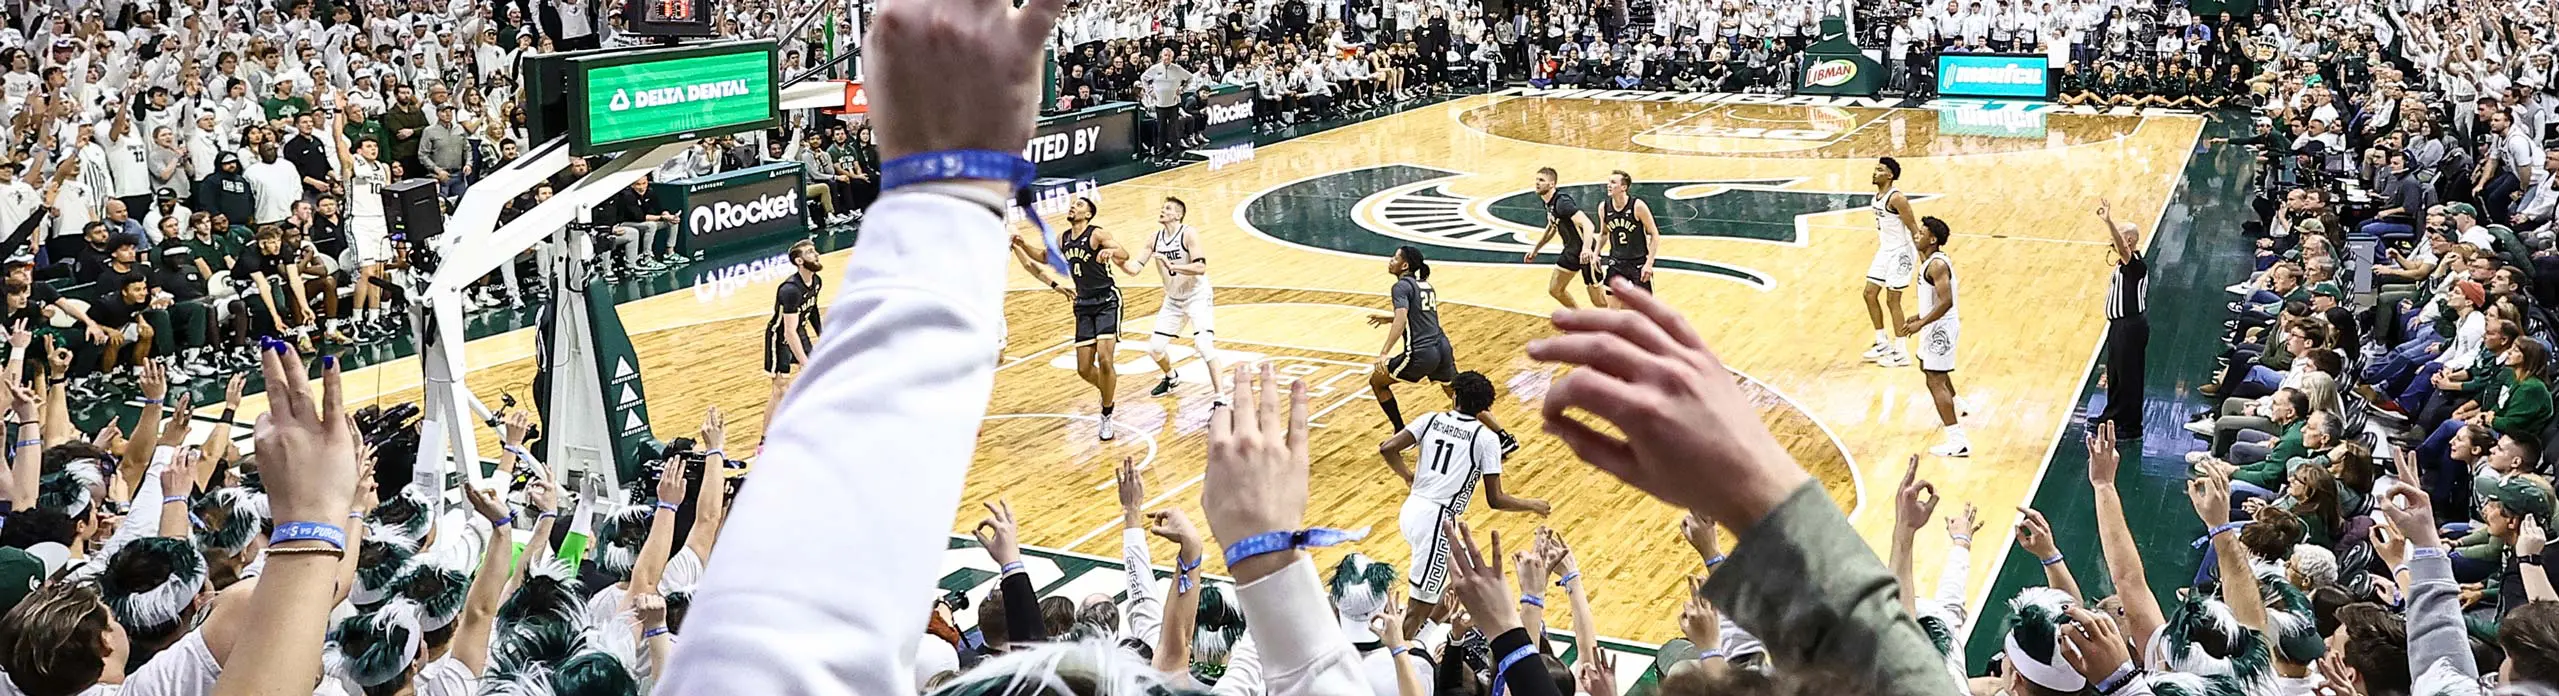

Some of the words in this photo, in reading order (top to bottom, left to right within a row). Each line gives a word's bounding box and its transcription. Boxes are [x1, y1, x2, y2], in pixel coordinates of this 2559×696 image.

[1807, 65, 1851, 84] LIBMAN
[634, 87, 686, 108] DELTA
[687, 79, 750, 101] DENTAL
[1212, 98, 1254, 125] Rocket
[1073, 126, 1101, 155] BY
[714, 187, 799, 231] Rocket
[1618, 232, 1628, 244] 2
[1064, 247, 1092, 262] URDUE
[1073, 263, 1083, 277] 4
[1420, 290, 1437, 311] 24
[1431, 439, 1455, 475] 11
[312, 525, 342, 541] PURD
